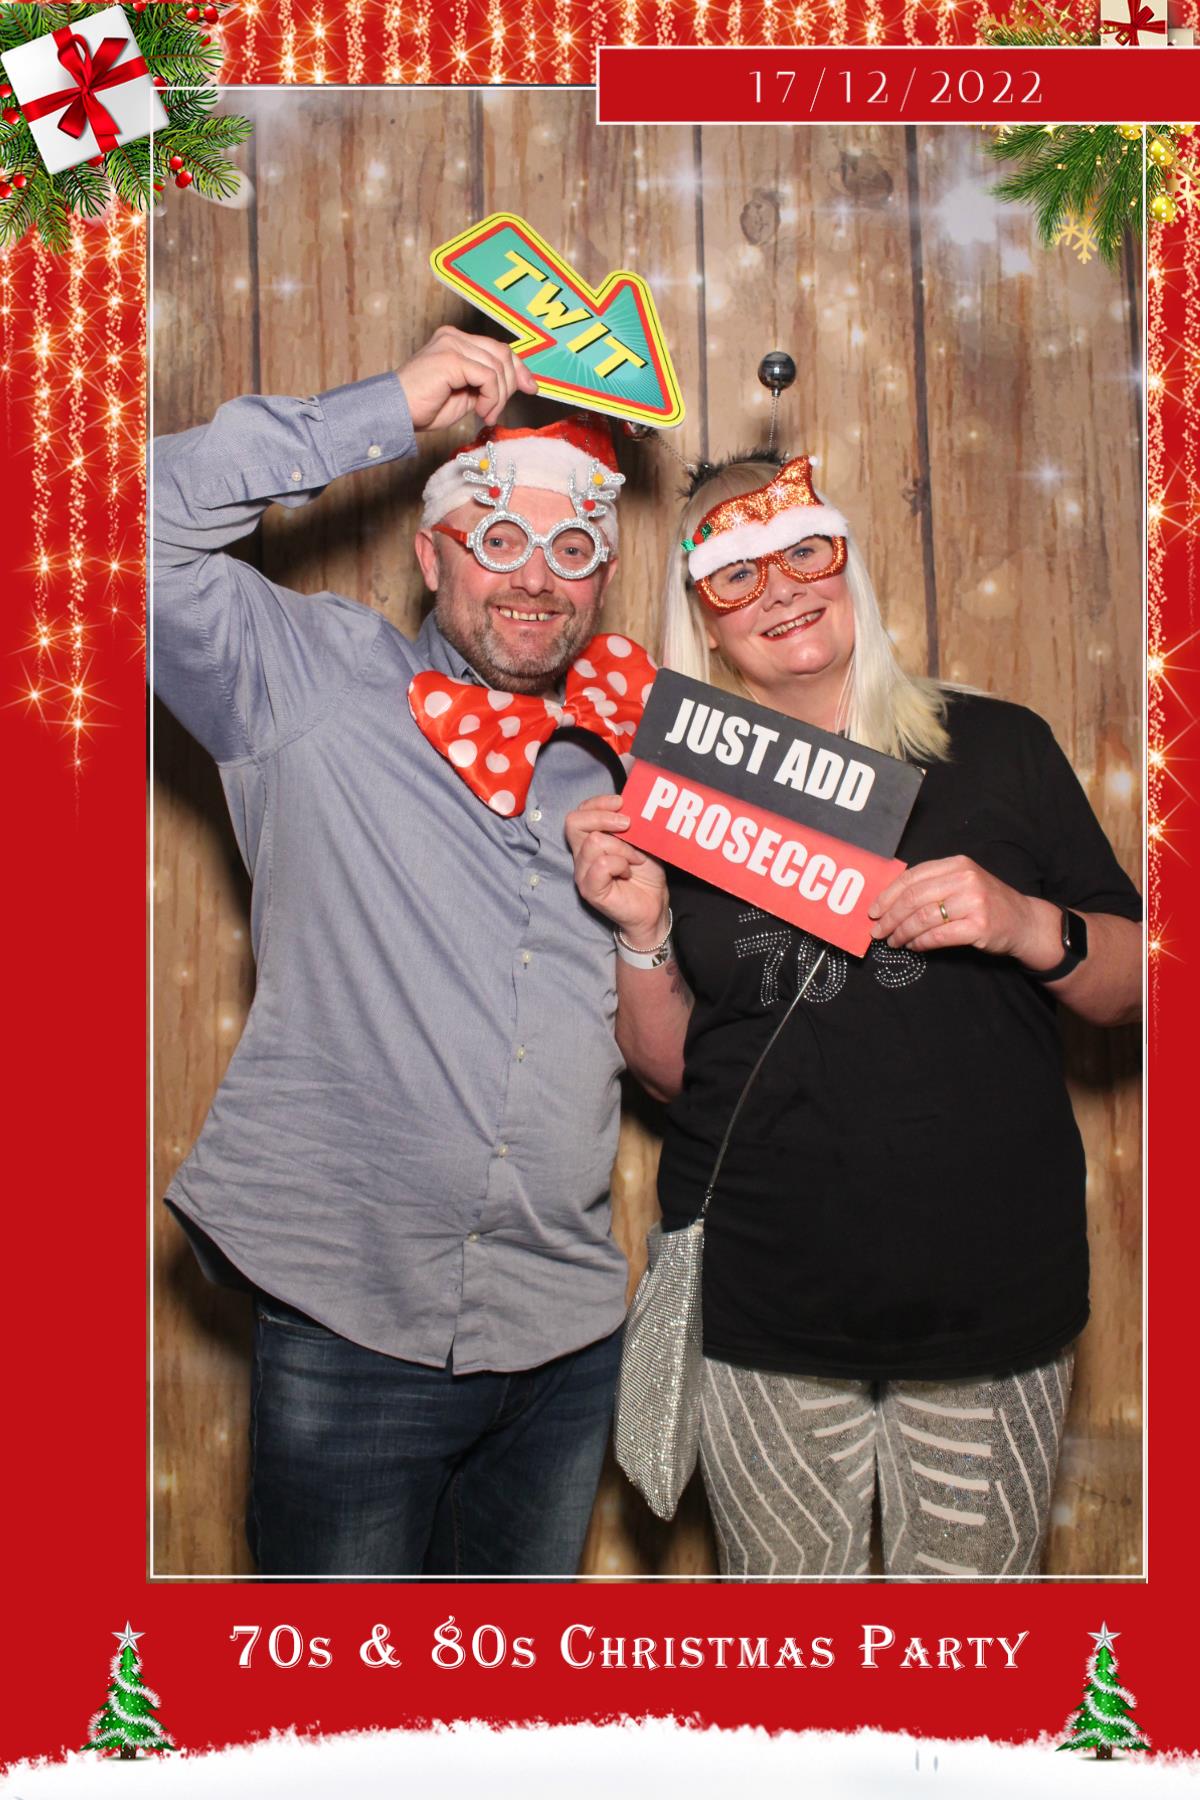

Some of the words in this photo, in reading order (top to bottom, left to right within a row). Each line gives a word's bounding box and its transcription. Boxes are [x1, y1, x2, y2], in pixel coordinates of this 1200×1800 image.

[494, 249, 649, 380] TWIT
[664, 697, 780, 776] JUST
[773, 738, 876, 813] ADD
[640, 775, 866, 916] PROSECCO
